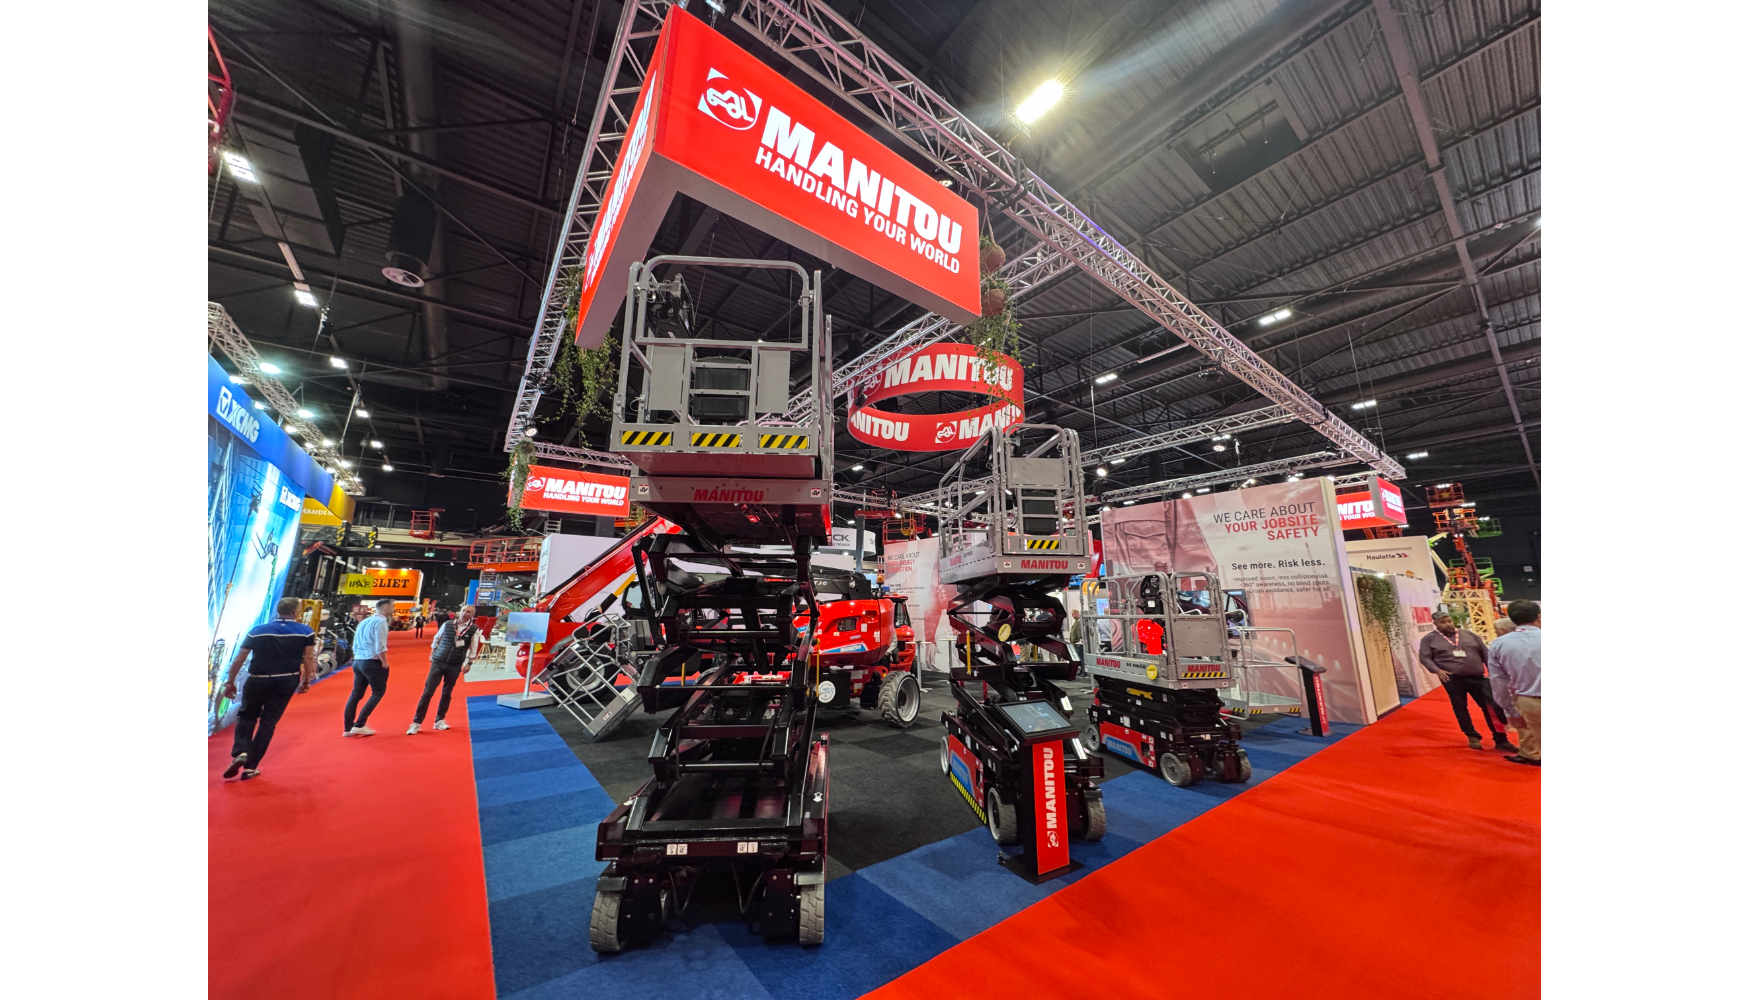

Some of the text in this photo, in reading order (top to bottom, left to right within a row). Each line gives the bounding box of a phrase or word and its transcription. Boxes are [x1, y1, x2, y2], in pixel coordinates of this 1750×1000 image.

[761, 105, 962, 254] MANITOU
[755, 146, 960, 274] HANDLING YOUR WORLD
[884, 354, 1013, 391] MANITOU
[227, 398, 260, 443] XCMG
[545, 478, 626, 499] MANITOU
[694, 489, 764, 502] MANITOU
[543, 491, 624, 506] HANDLING YOUR WORLD
[1213, 501, 1315, 523] WE CARE ABOUT
[1224, 513, 1319, 533] YOUR JOBSITE
[1267, 526, 1319, 540] SAFETY
[1020, 560, 1069, 569] MANITOU
[1232, 562, 1248, 570] See
[1278, 559, 1299, 568] Risk
[1301, 558, 1325, 567] less.
[349, 579, 370, 588] IPAF
[372, 578, 410, 588] ELIET
[1096, 657, 1121, 669] MANITOU
[1187, 664, 1221, 673] MANITOU
[1043, 747, 1058, 829] MANITOU
